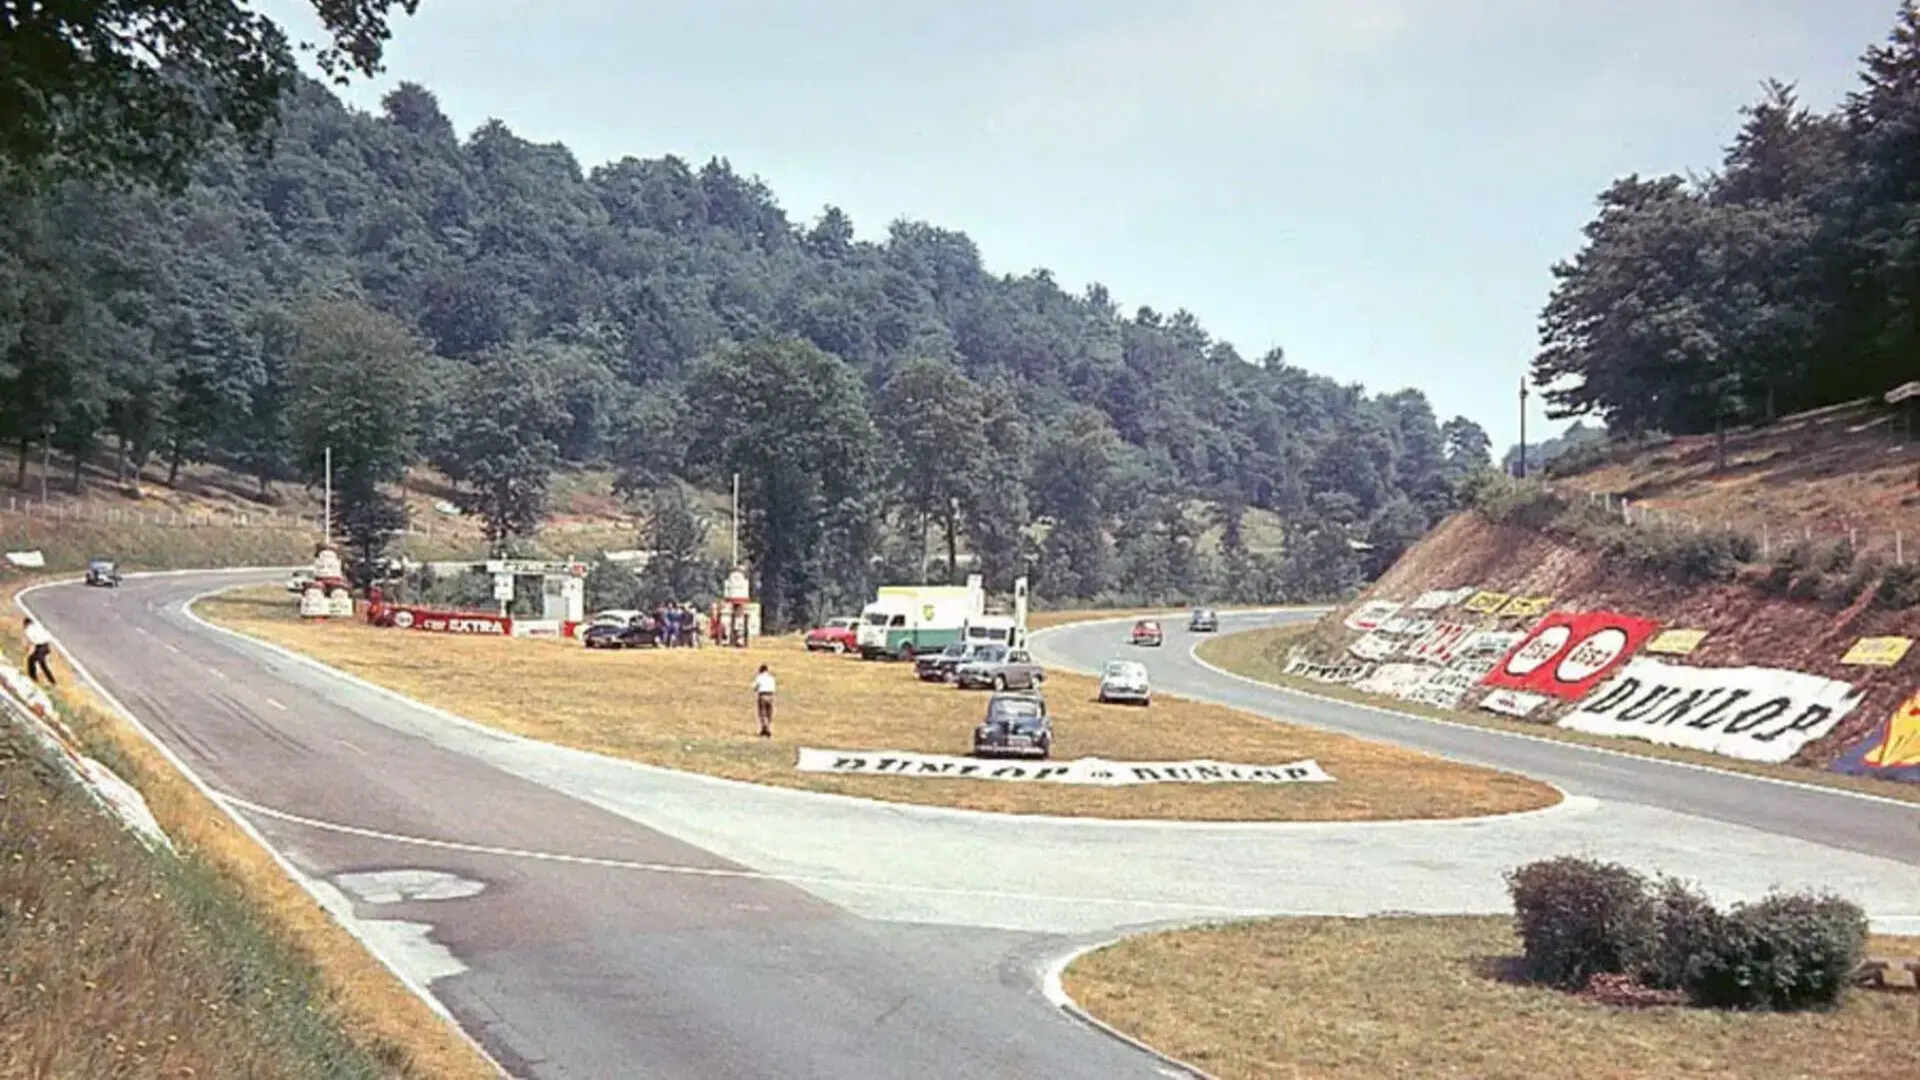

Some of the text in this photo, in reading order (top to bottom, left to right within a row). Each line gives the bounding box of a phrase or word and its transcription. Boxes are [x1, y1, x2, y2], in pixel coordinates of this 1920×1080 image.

[1582, 677, 1832, 741] DUNLOP
[833, 757, 1069, 779] DUNLOP
[1131, 765, 1309, 780] DUNLOP
